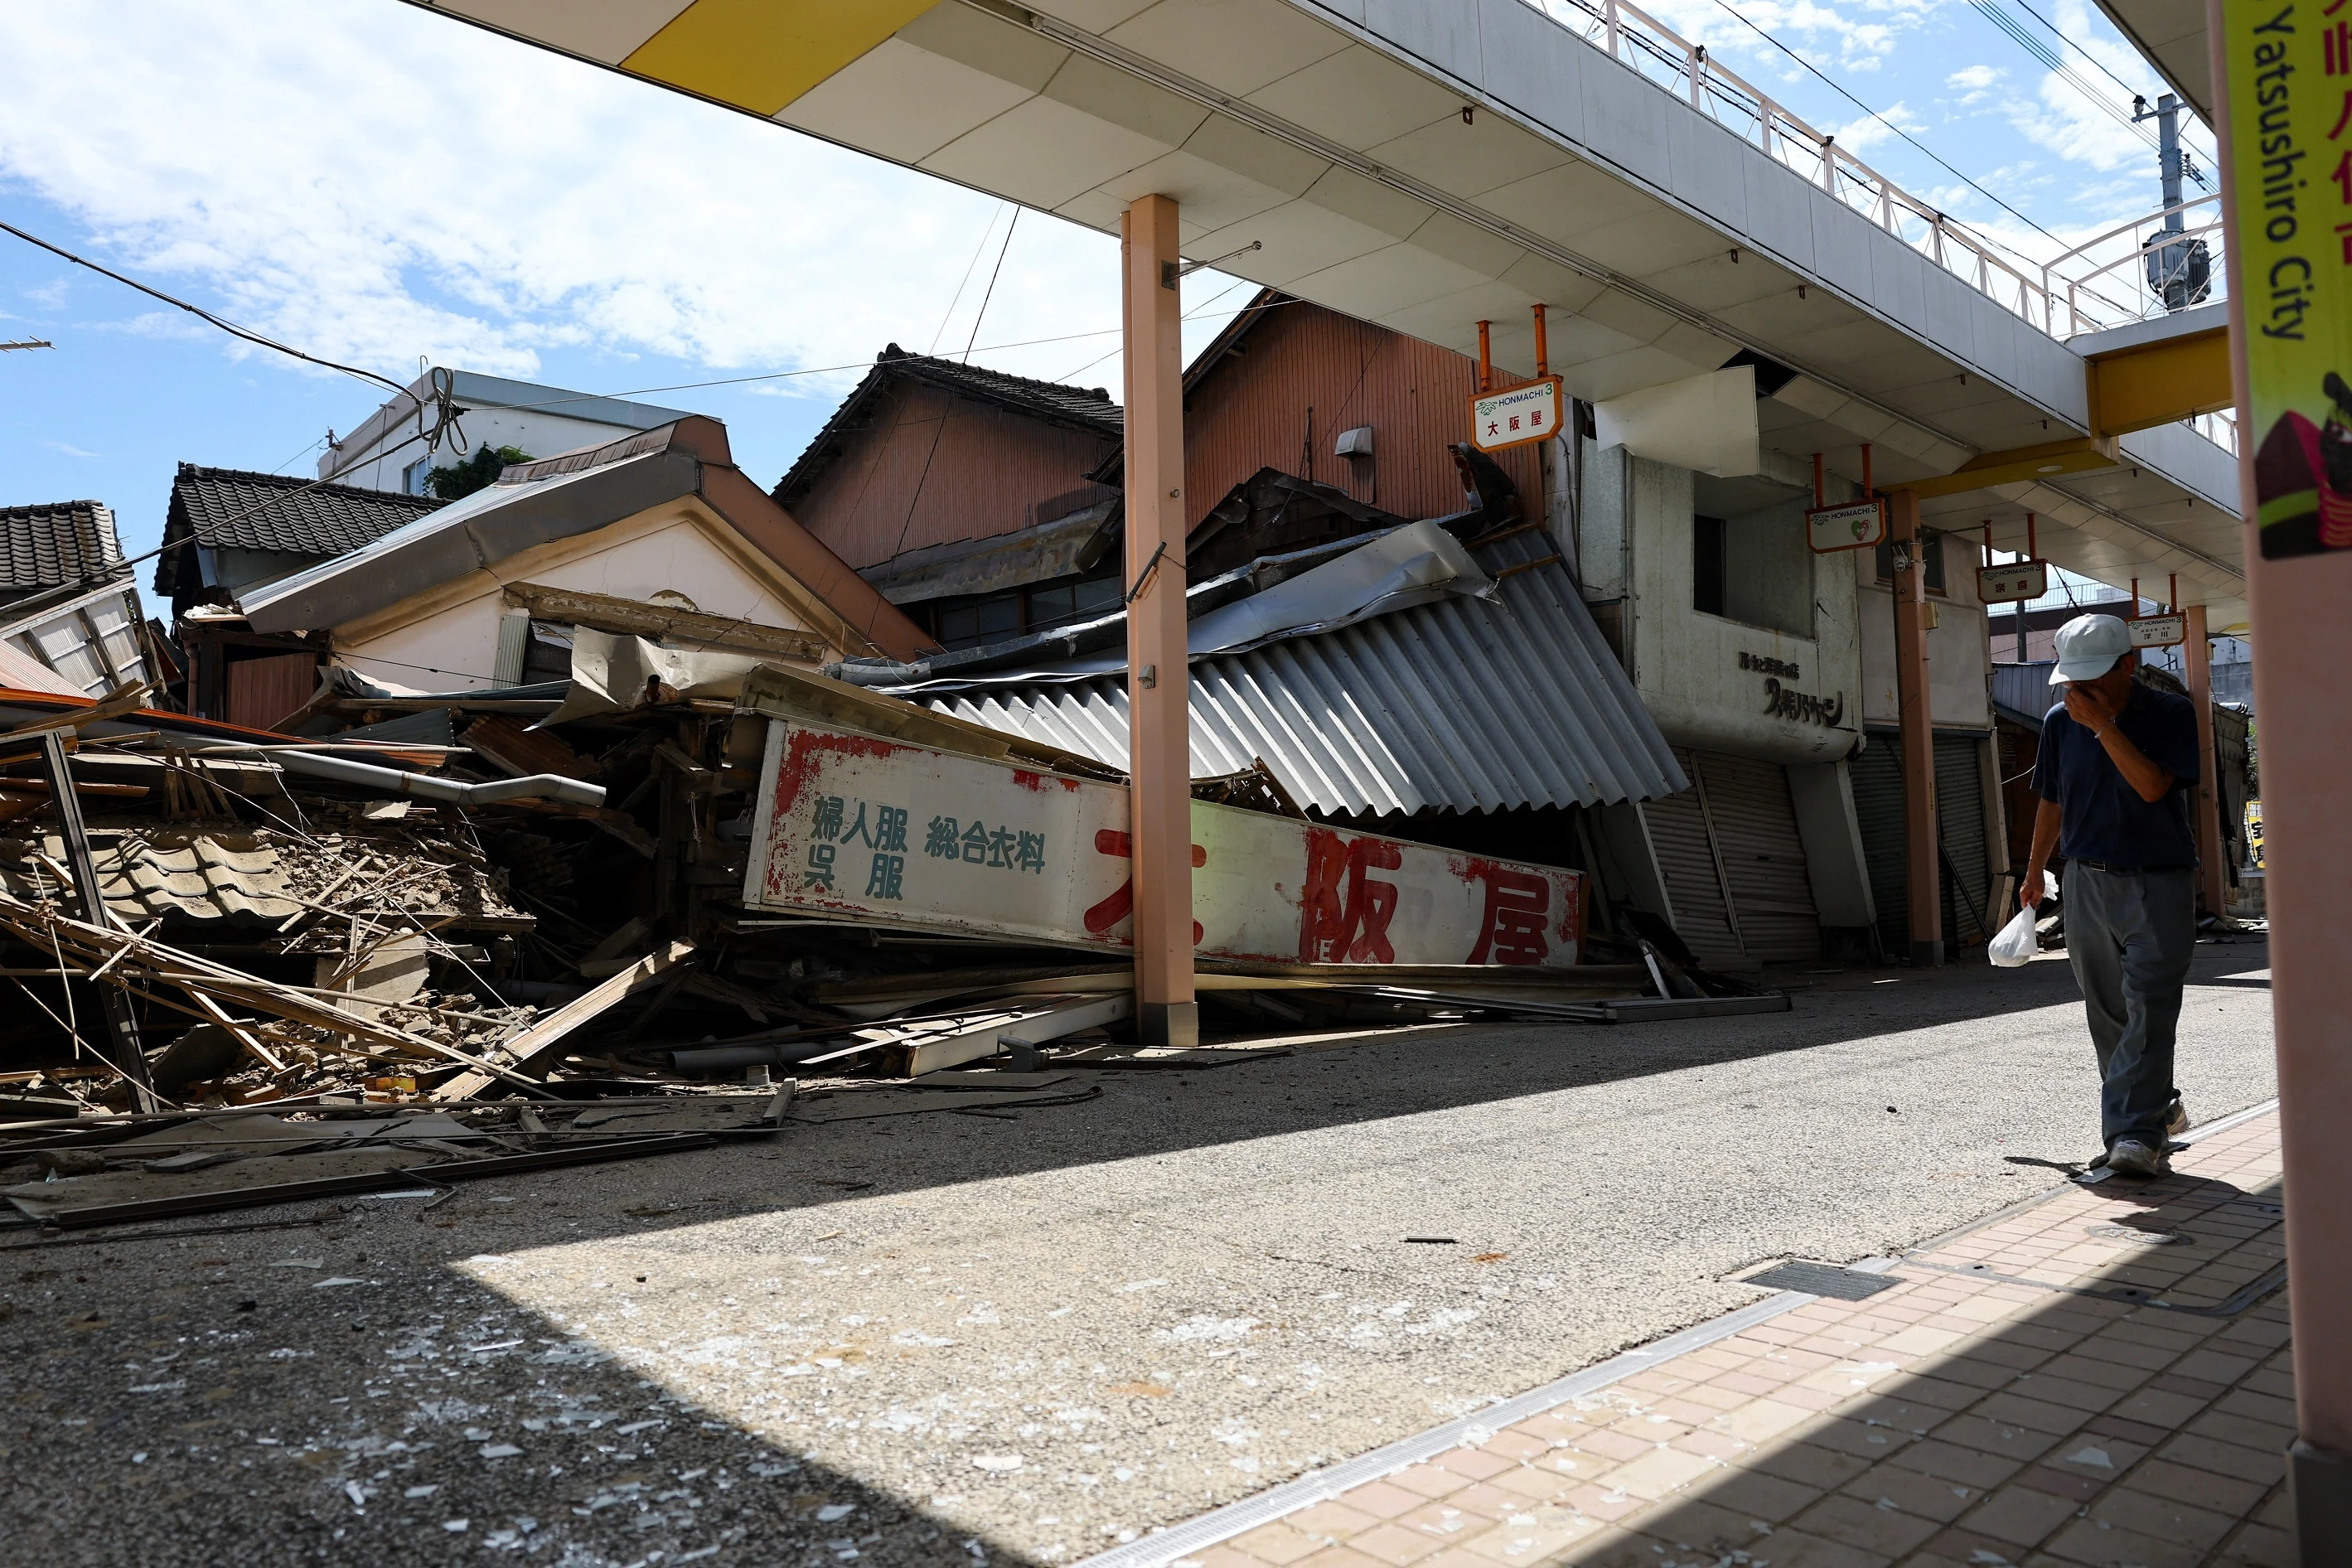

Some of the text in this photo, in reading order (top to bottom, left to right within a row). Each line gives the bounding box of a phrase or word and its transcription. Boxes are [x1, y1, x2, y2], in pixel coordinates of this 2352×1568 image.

[2253, 5, 2315, 341] Yatsushiro City
[1498, 383, 1553, 407] HONMACHI 3
[1488, 410, 1542, 437] 大阪屋
[1831, 503, 1878, 520] HONMACHI 3
[1999, 563, 2041, 577] HONMACHI 3
[810, 796, 1046, 875] 婦人服 総合衣料
[803, 844, 905, 902] 呉服
